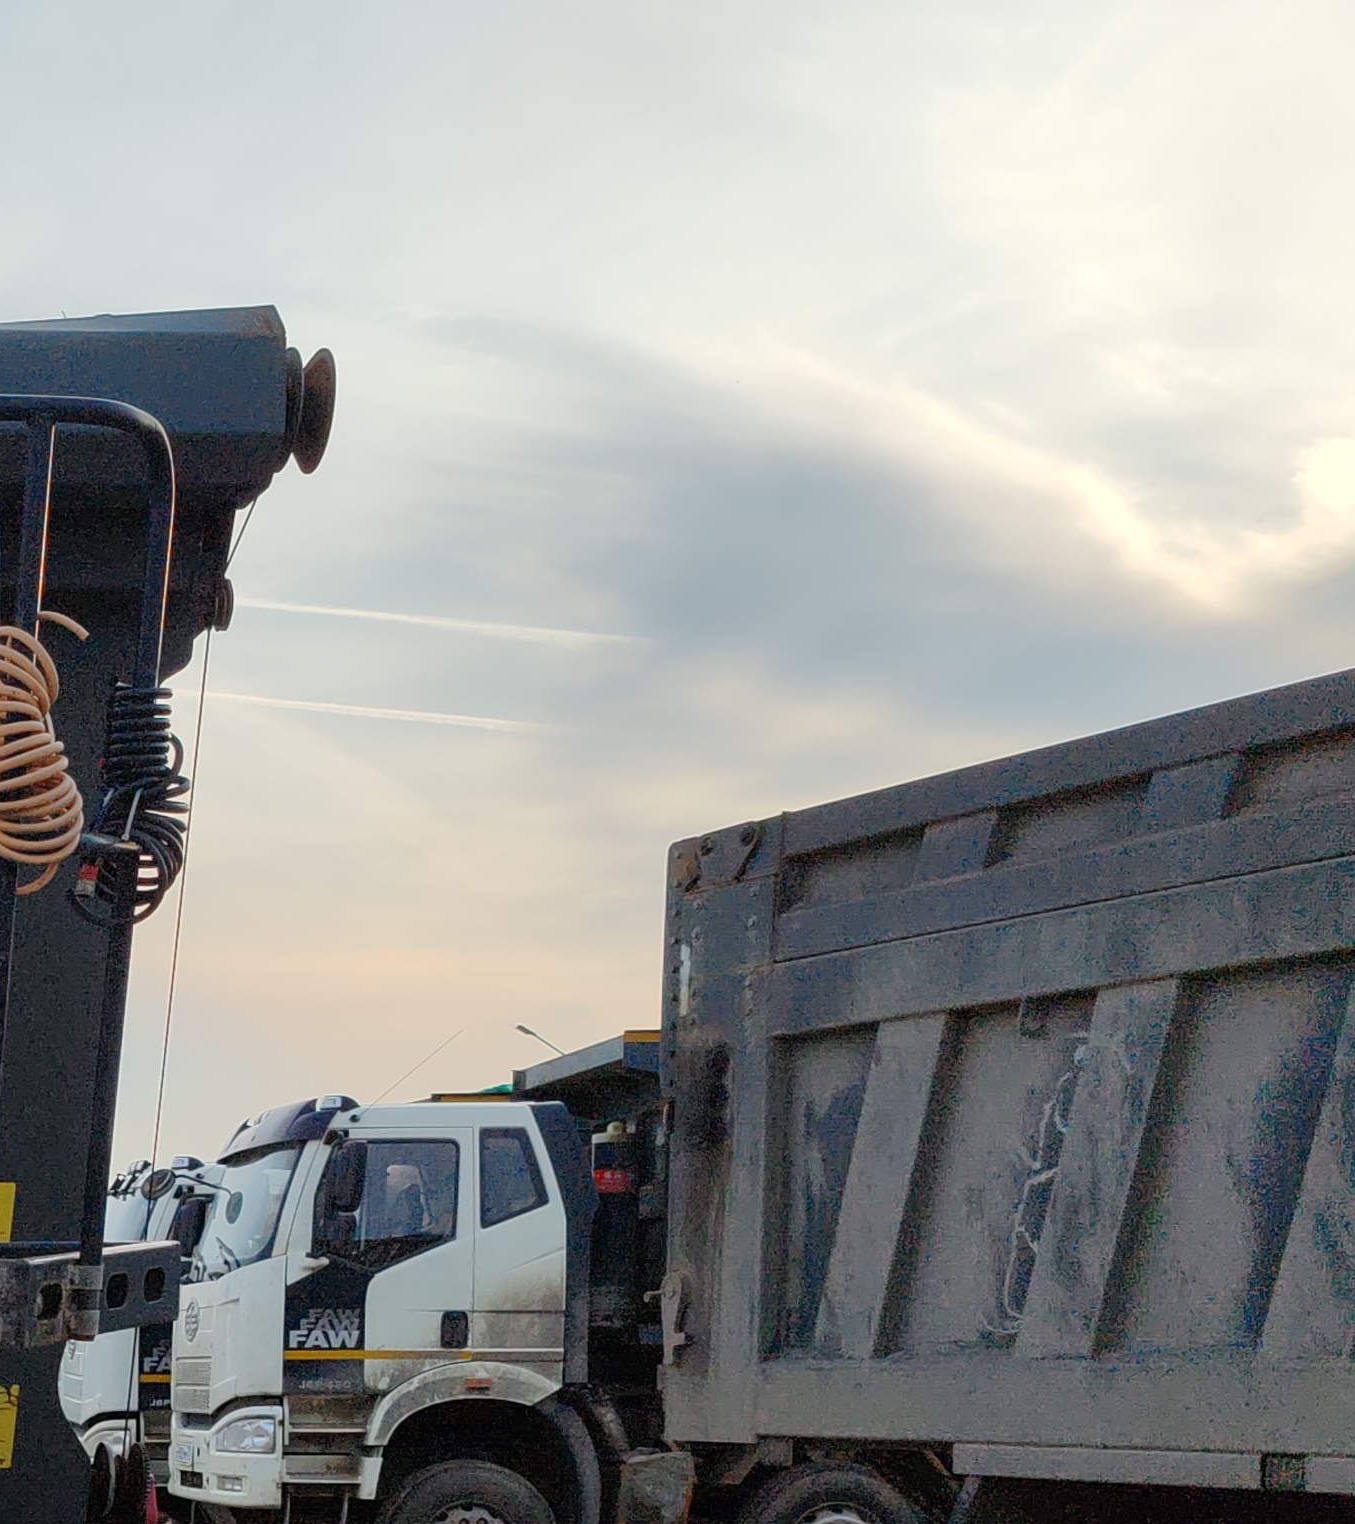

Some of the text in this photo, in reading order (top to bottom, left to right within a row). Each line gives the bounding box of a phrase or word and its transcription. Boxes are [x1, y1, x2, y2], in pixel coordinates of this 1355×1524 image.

[300, 1319, 360, 1334] FAW
[289, 1330, 360, 1349] FAW
[143, 1356, 171, 1373] FA
